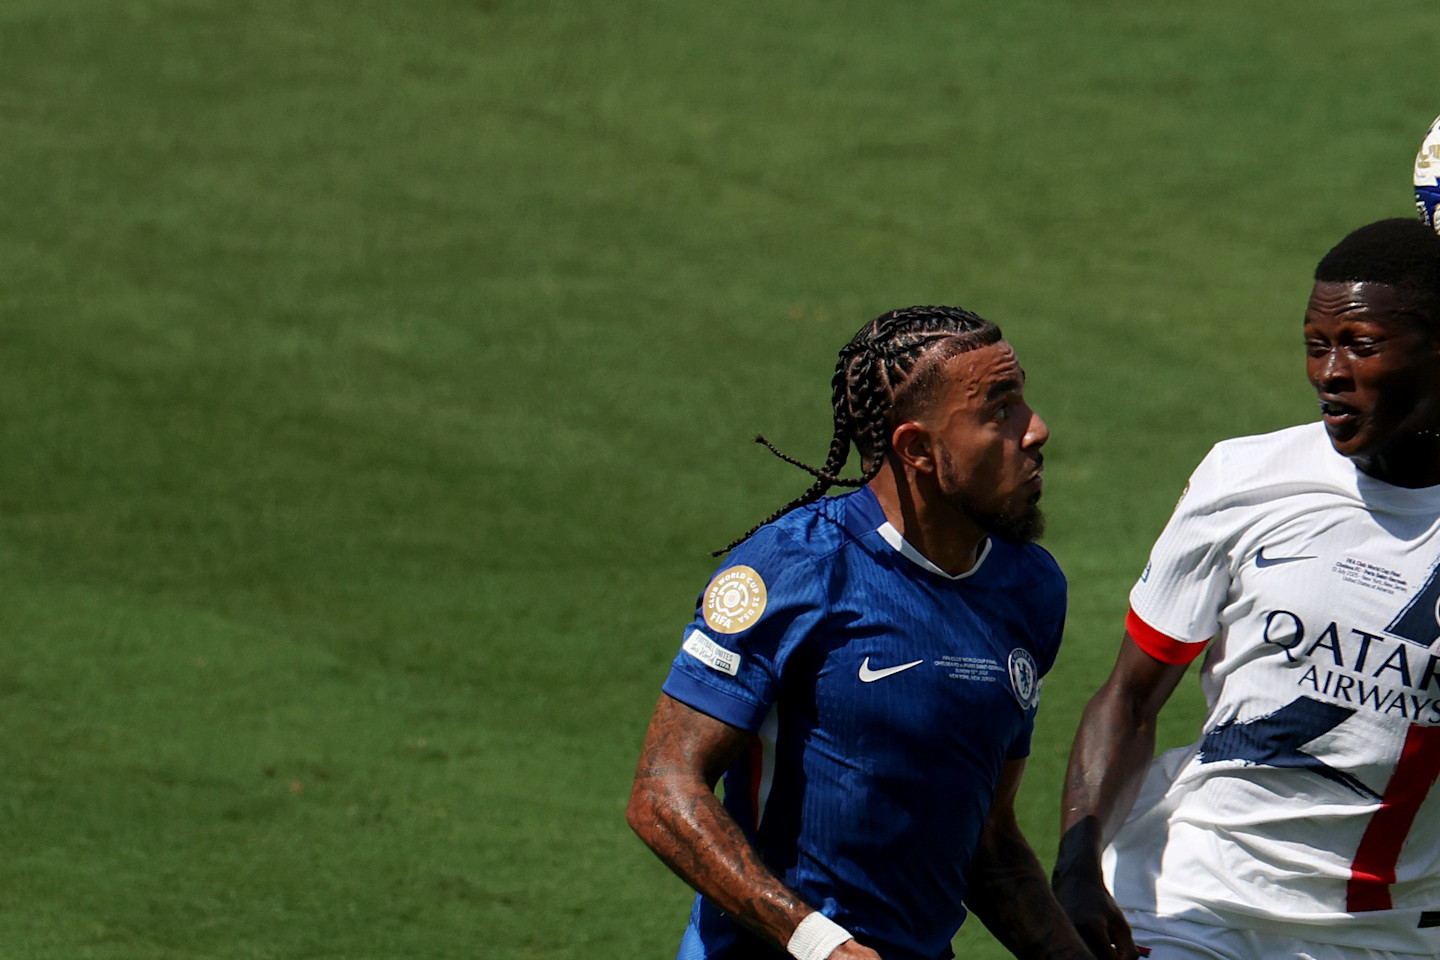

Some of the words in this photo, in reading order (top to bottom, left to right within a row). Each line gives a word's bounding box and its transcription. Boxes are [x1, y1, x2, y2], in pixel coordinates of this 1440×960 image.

[717, 572, 746, 586] WORLD
[746, 577, 760, 594] CUP
[708, 586, 719, 609] CLUB
[751, 596, 760, 608] 25
[709, 611, 733, 629] FIFA
[737, 609, 756, 624] USA
